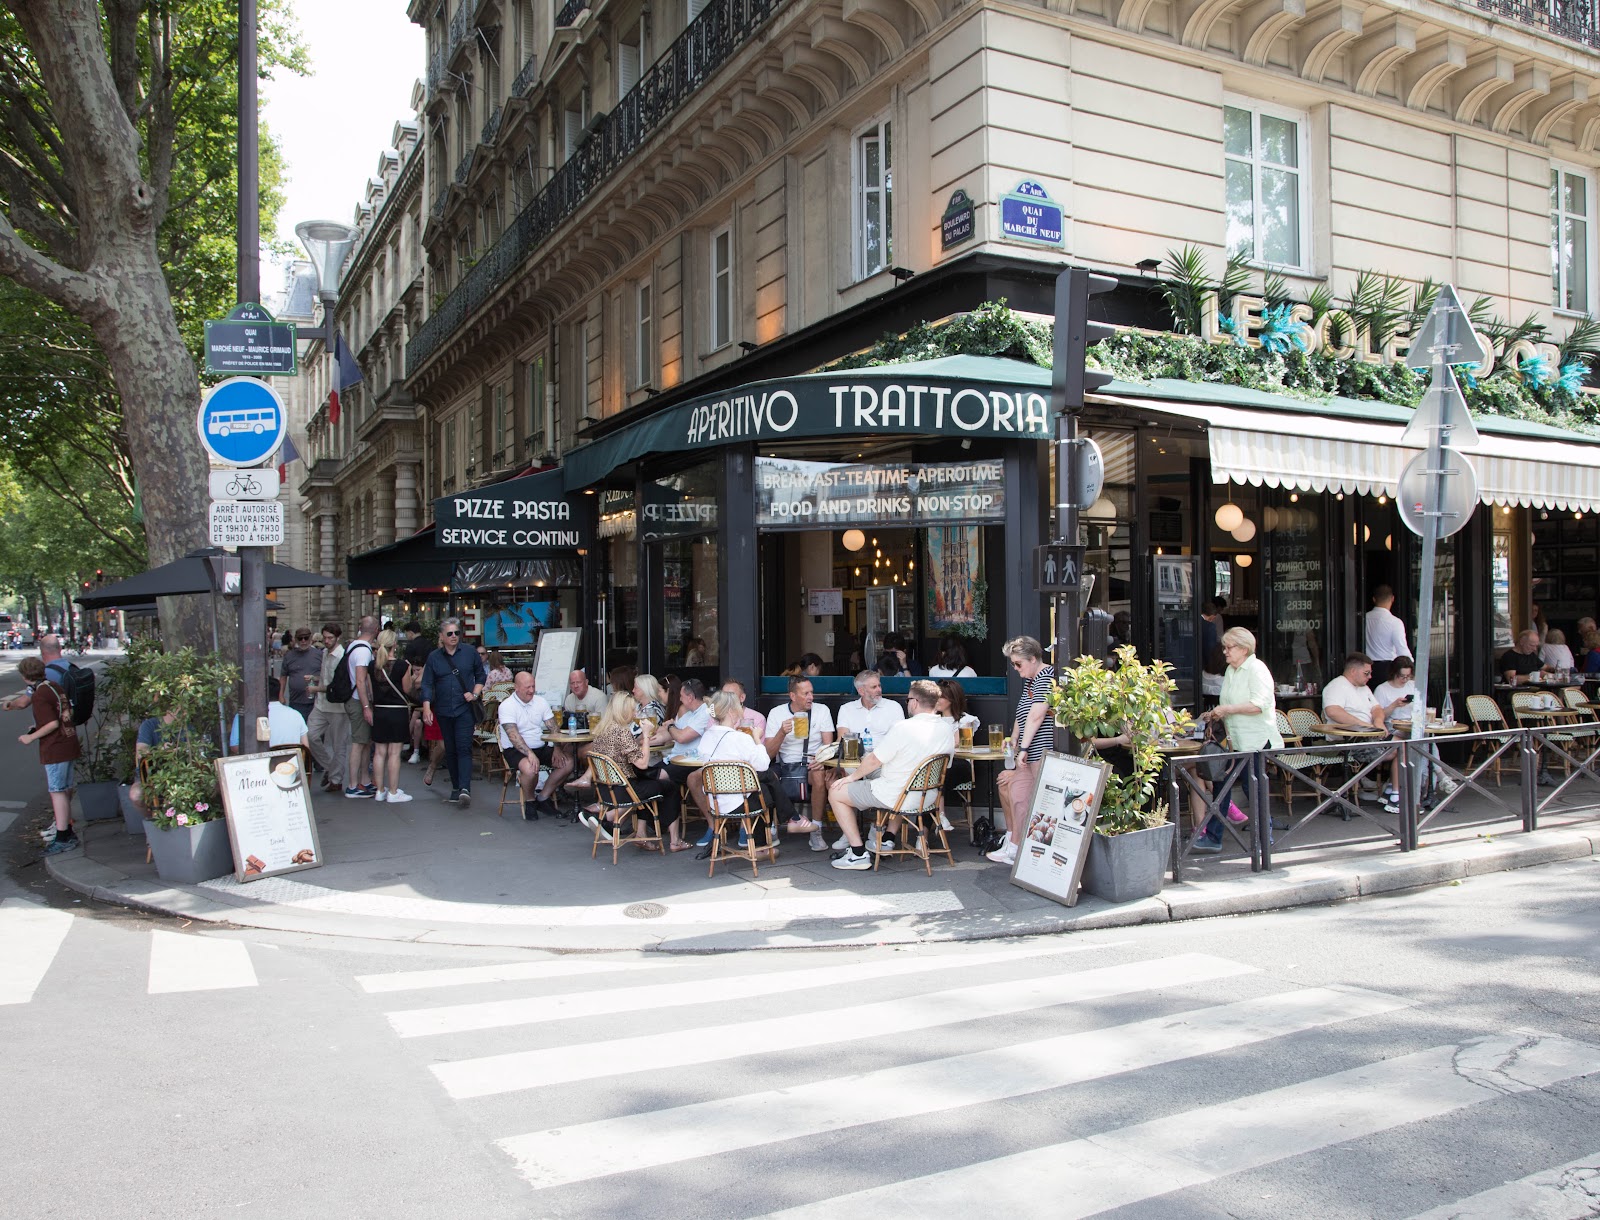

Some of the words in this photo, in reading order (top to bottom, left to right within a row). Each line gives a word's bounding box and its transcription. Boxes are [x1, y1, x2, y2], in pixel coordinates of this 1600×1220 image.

[1022, 206, 1042, 216] QUAI
[944, 210, 970, 230] BOULEVARD
[1027, 216, 1038, 225] DU
[945, 232, 952, 242] DU
[953, 223, 970, 237] PALAIS
[1004, 222, 1038, 236] MARCHÉ
[1040, 228, 1060, 240] NEUF
[1200, 290, 1266, 350] LE
[211, 344, 231, 352] MARCHÉ
[688, 390, 798, 444] APERITIVO
[828, 384, 1049, 433] TRATTORIA
[216, 504, 239, 513] ARRÊT
[242, 504, 277, 513] AUTORISÉ
[454, 498, 504, 519] PIZZE
[512, 500, 570, 521] PASTA
[770, 501, 813, 516] FOOD
[818, 500, 851, 514] AND
[856, 497, 910, 514] DRINKS
[918, 494, 993, 512] NON-STOP
[249, 533, 254, 542] À
[442, 529, 507, 545] SERVICE
[513, 530, 579, 546] CONTINU
[239, 778, 267, 790] Menu
